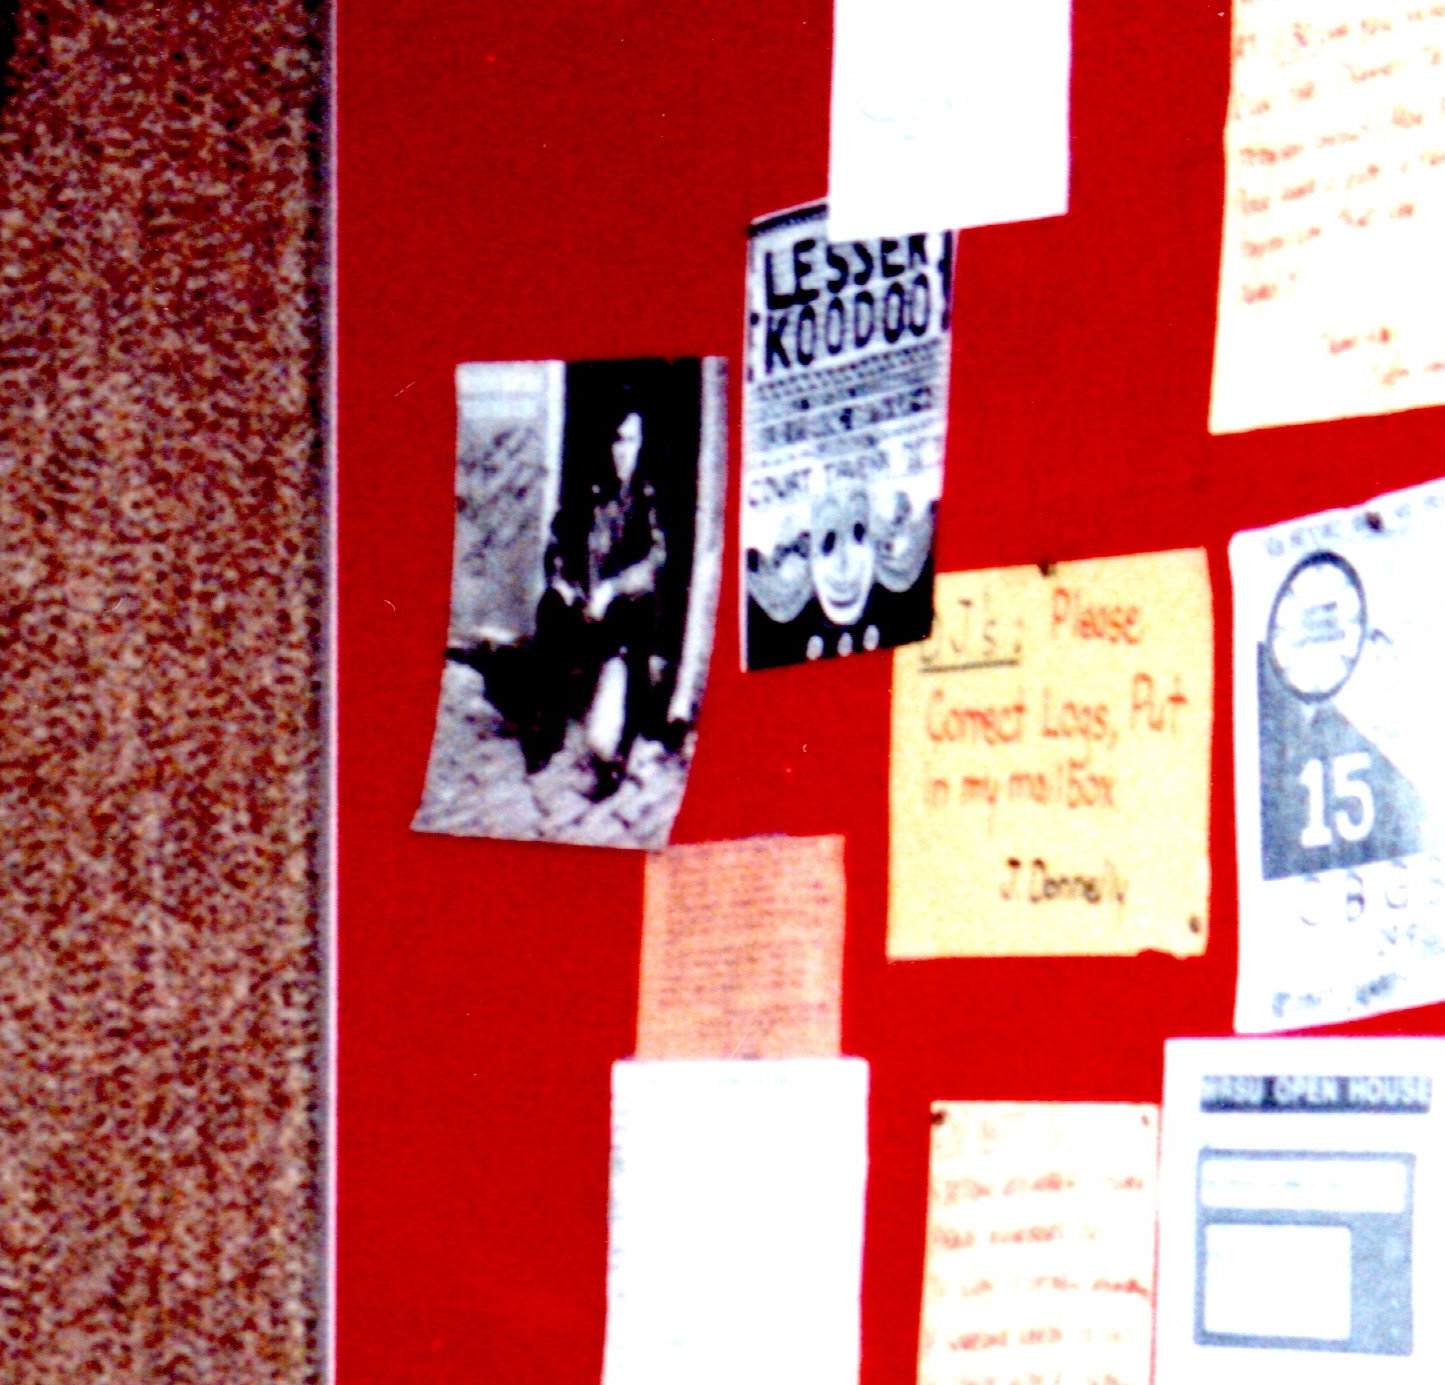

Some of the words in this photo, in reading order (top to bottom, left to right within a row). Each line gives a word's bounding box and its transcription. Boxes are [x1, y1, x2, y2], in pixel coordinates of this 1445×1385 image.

[765, 233, 929, 310] LESSER
[765, 272, 930, 375] KOODOO
[1051, 586, 1139, 645] Please
[925, 688, 1026, 746] Correct
[1130, 672, 1188, 736] Put
[1300, 752, 1375, 849] 15
[1274, 1076, 1338, 1105] OPEN
[1347, 1077, 1432, 1106] HOUSE
